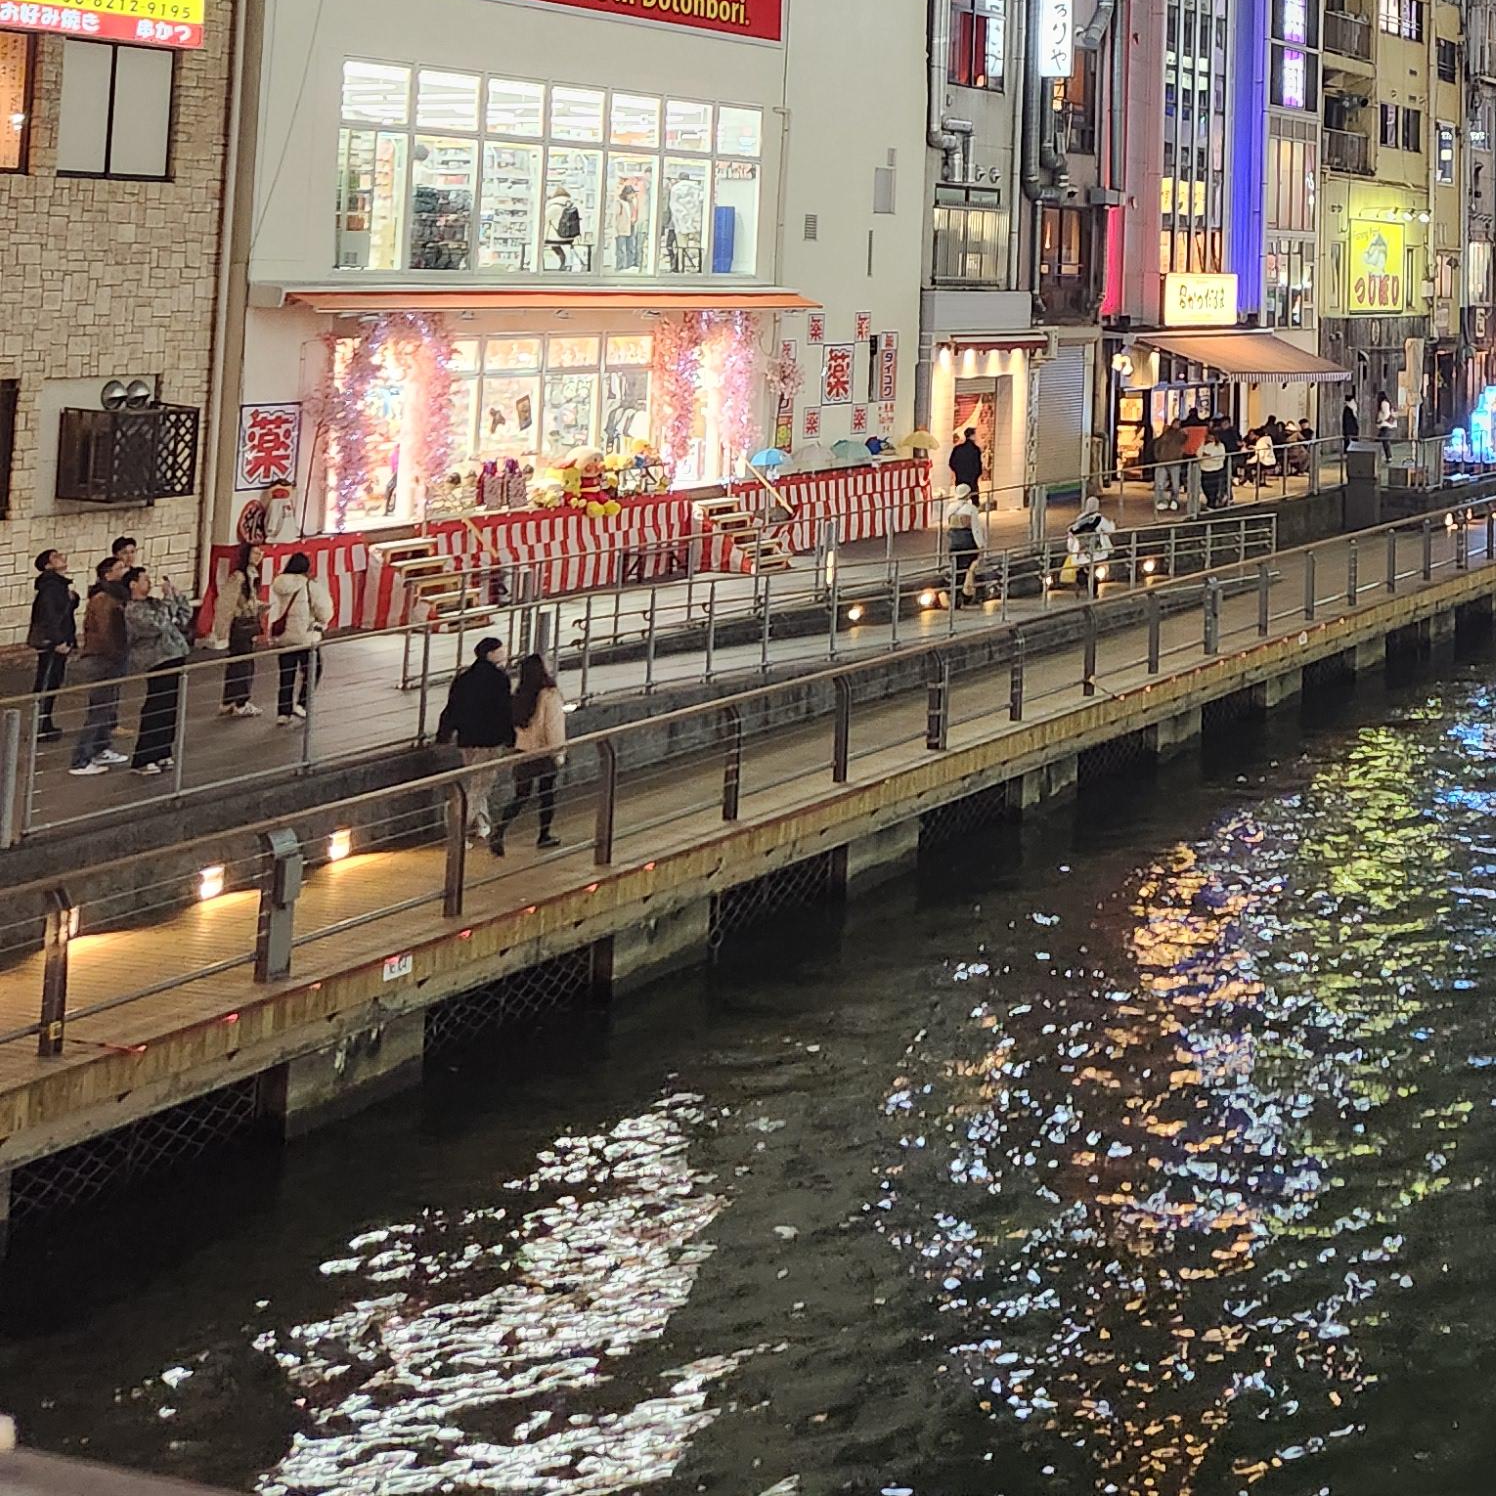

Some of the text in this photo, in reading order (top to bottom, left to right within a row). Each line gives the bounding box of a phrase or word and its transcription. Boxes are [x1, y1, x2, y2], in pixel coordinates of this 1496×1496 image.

[0, 1, 192, 42] お好み焼き 串かつ
[826, 347, 851, 401] 薬
[245, 408, 295, 480] 薬
